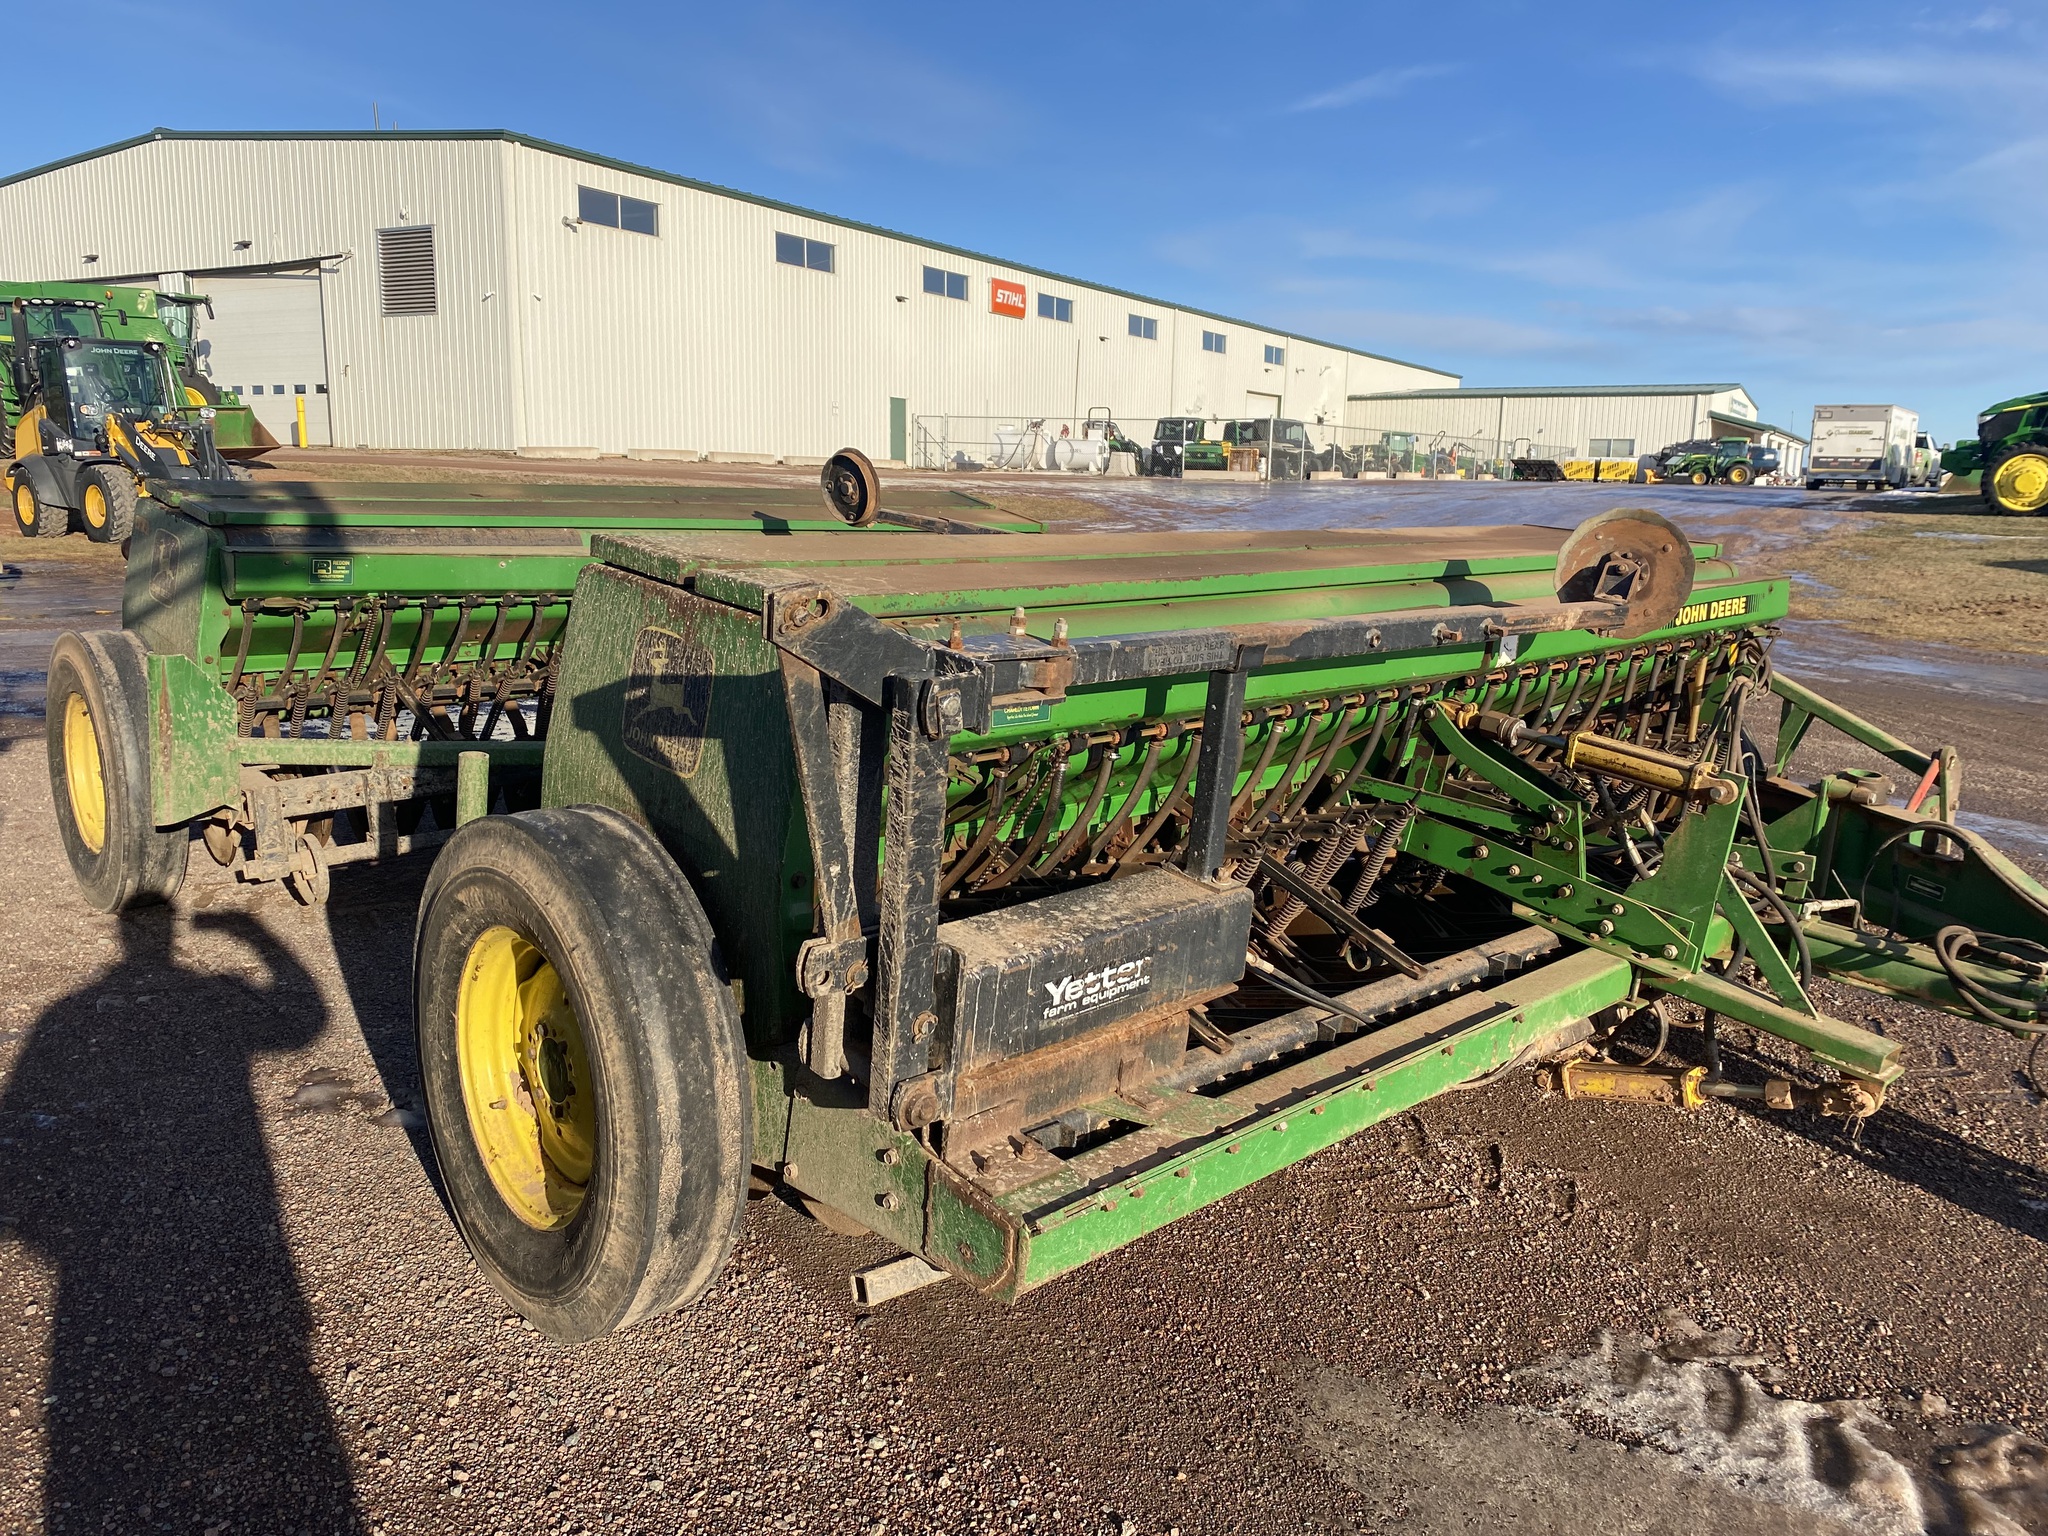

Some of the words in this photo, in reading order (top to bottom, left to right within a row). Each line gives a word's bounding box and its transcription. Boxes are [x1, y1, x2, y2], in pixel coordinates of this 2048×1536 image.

[996, 289, 1025, 308] STIHL
[135, 436, 156, 461] DEERE
[1675, 603, 1708, 626] JOHN
[1710, 596, 1747, 619] DEERE
[626, 725, 656, 749] JOHN
[657, 736, 695, 766] DEERE
[1043, 1000, 1077, 1019] farm
[1082, 975, 1151, 1006] equipment
